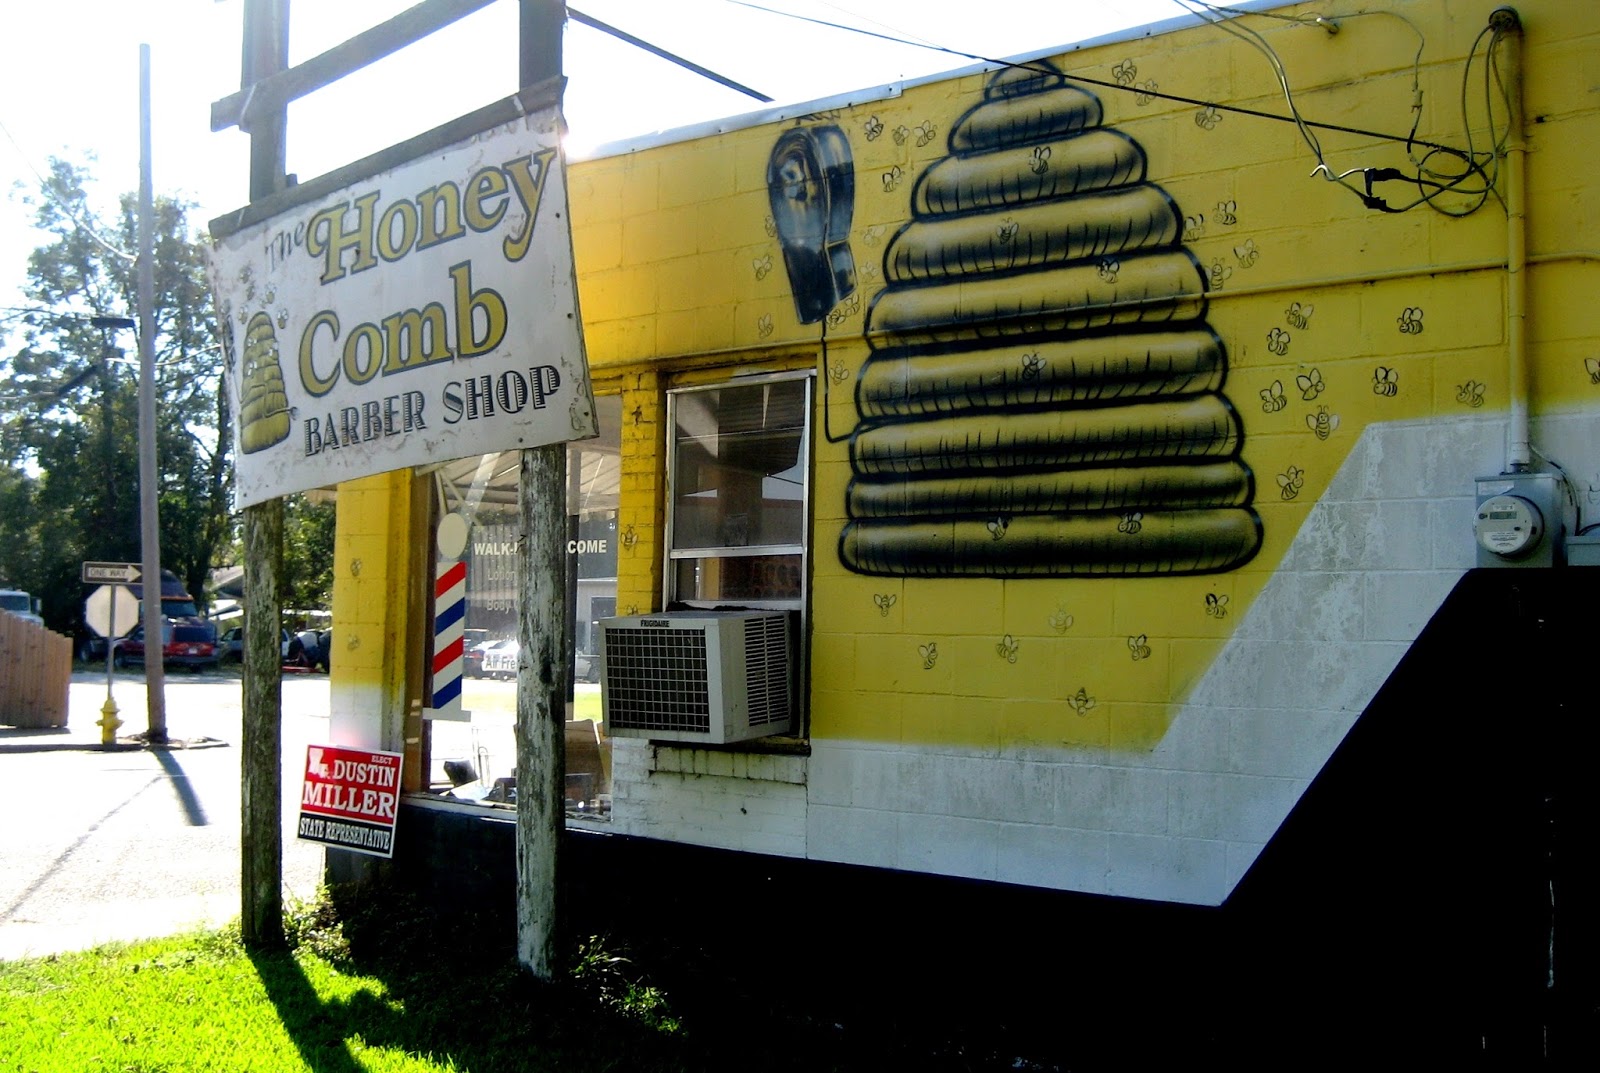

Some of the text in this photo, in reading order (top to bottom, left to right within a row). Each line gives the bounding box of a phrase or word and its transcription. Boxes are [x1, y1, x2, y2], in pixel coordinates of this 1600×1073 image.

[264, 148, 557, 285] The Honey
[298, 259, 508, 398] Comb
[304, 365, 561, 456] BARBER SHOP
[474, 540, 607, 556] WALK-I COME
[91, 568, 127, 577] ONE WAY
[487, 599, 511, 614] Body
[485, 655, 516, 669] Air Fre
[372, 755, 393, 764] ELECT
[333, 760, 395, 787] DUSTIN
[302, 781, 394, 818] MILLER
[300, 818, 390, 849] STATE REPRESENTATIVE
